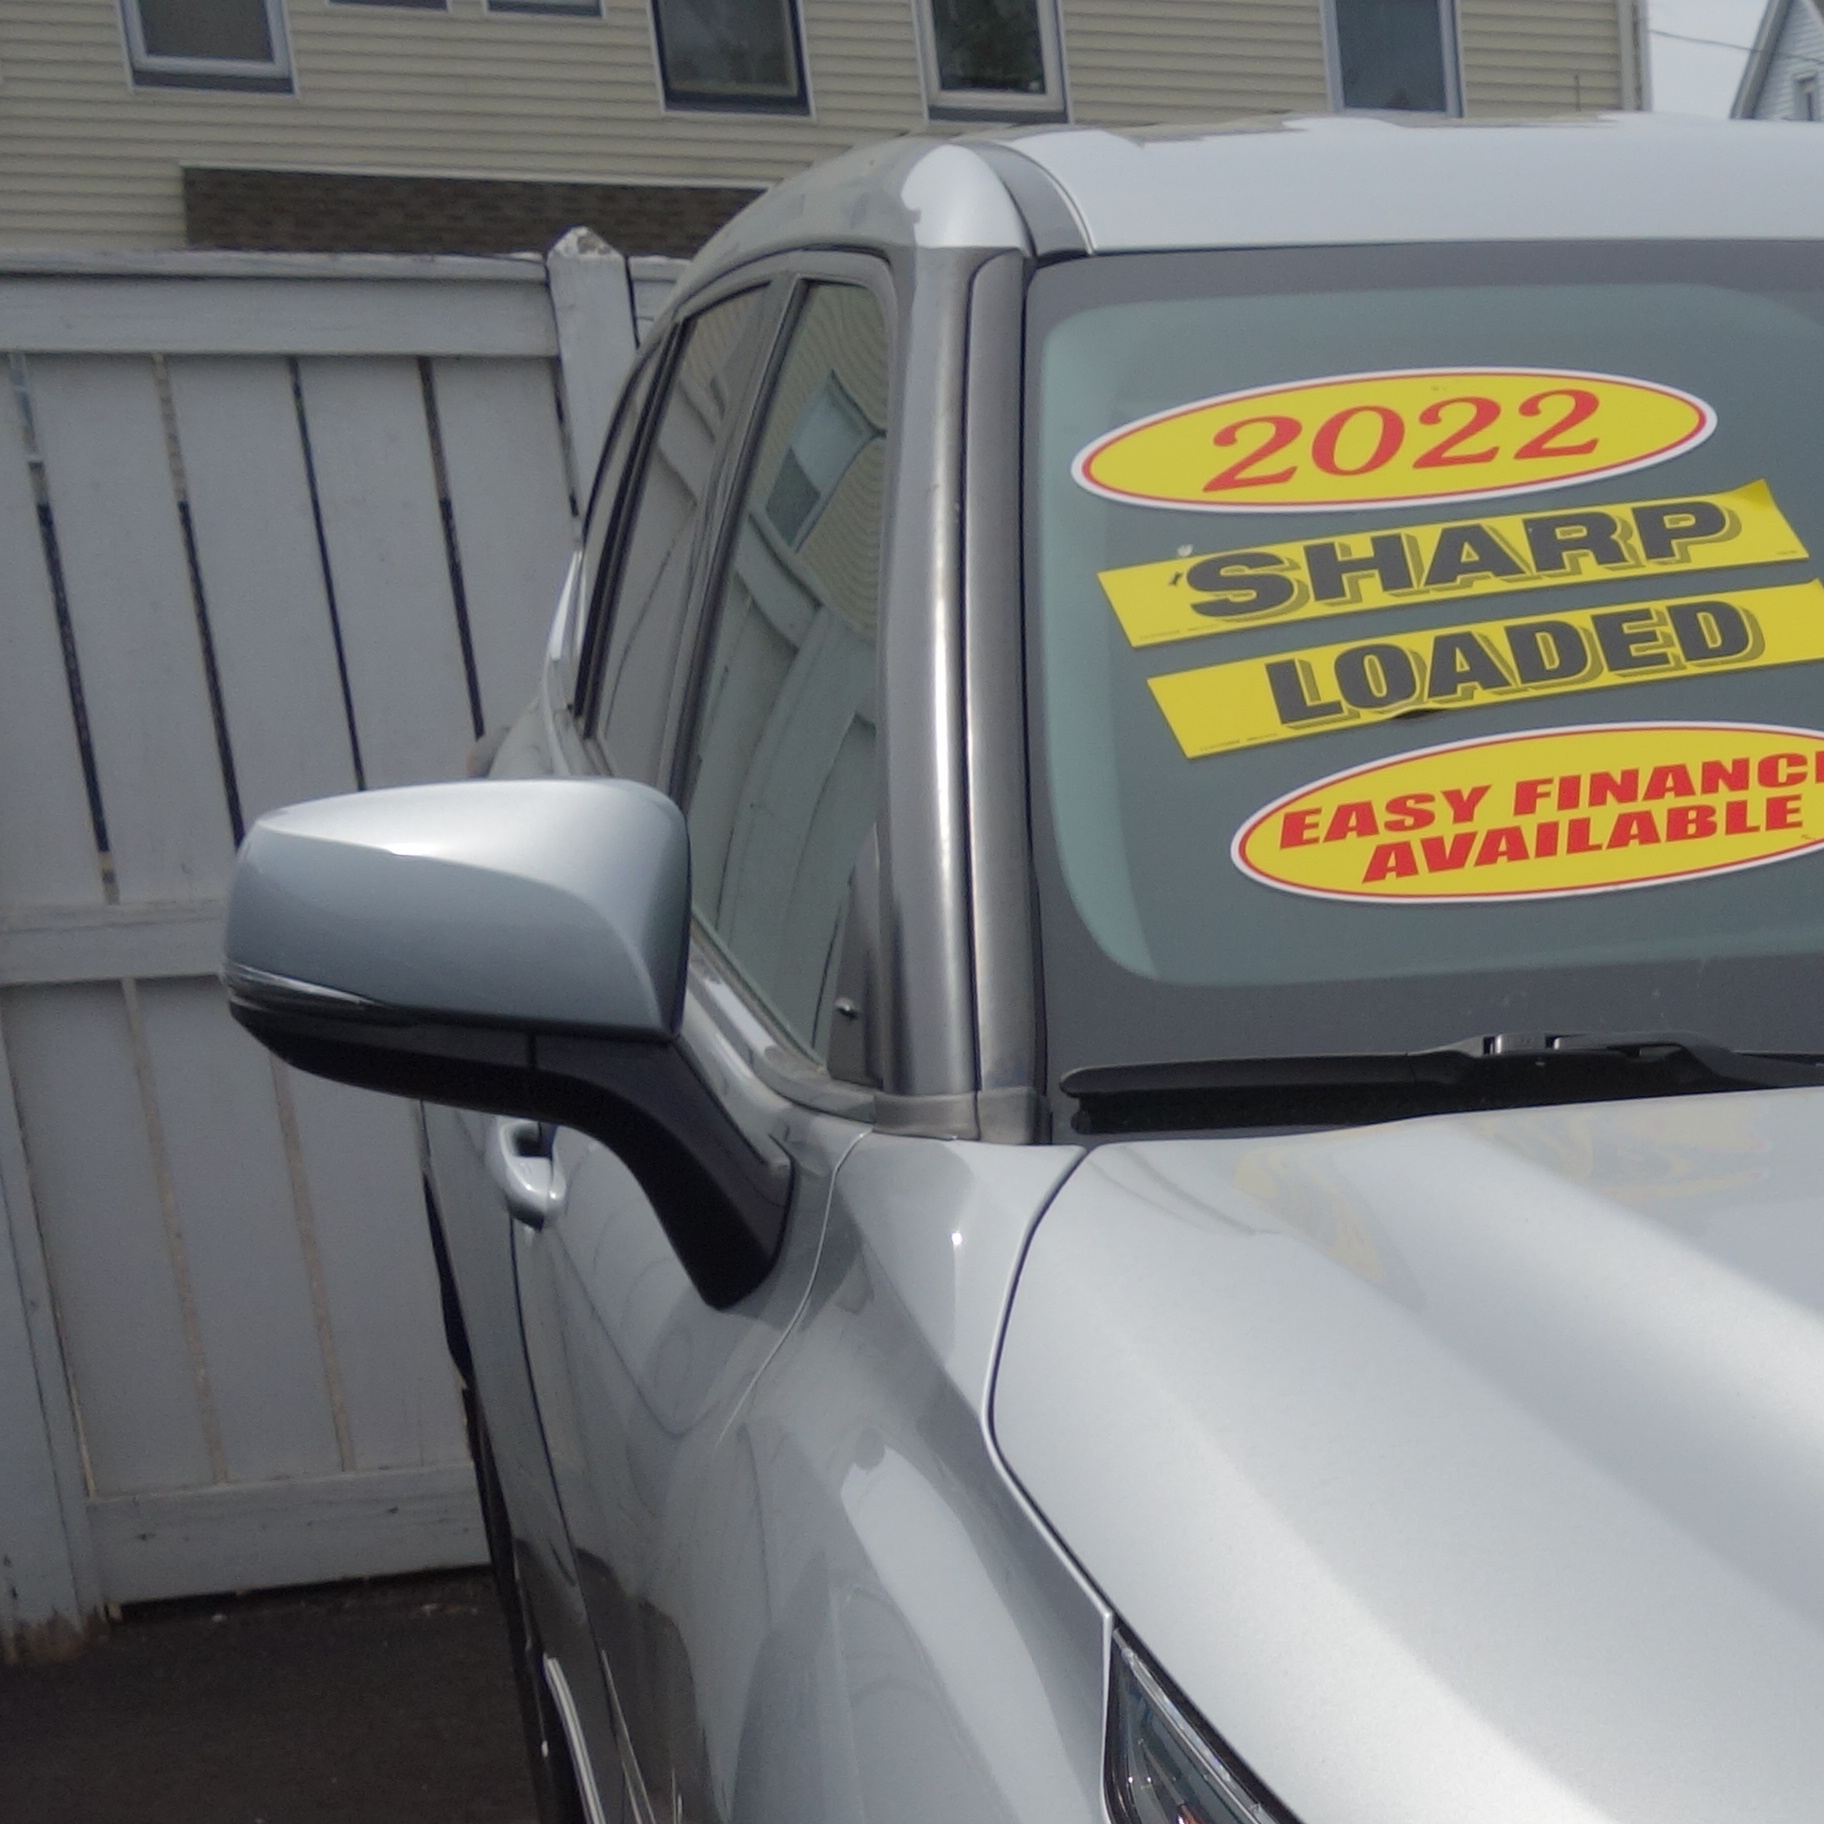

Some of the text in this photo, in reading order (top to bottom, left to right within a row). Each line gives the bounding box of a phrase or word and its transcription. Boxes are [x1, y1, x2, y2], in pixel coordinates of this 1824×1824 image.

[1202, 387, 1601, 494] 2022
[1186, 500, 1735, 620] SHARP
[1265, 599, 1755, 728] LOADED
[1278, 784, 1492, 851] EASY
[1360, 792, 1805, 885] AVAILABLE
